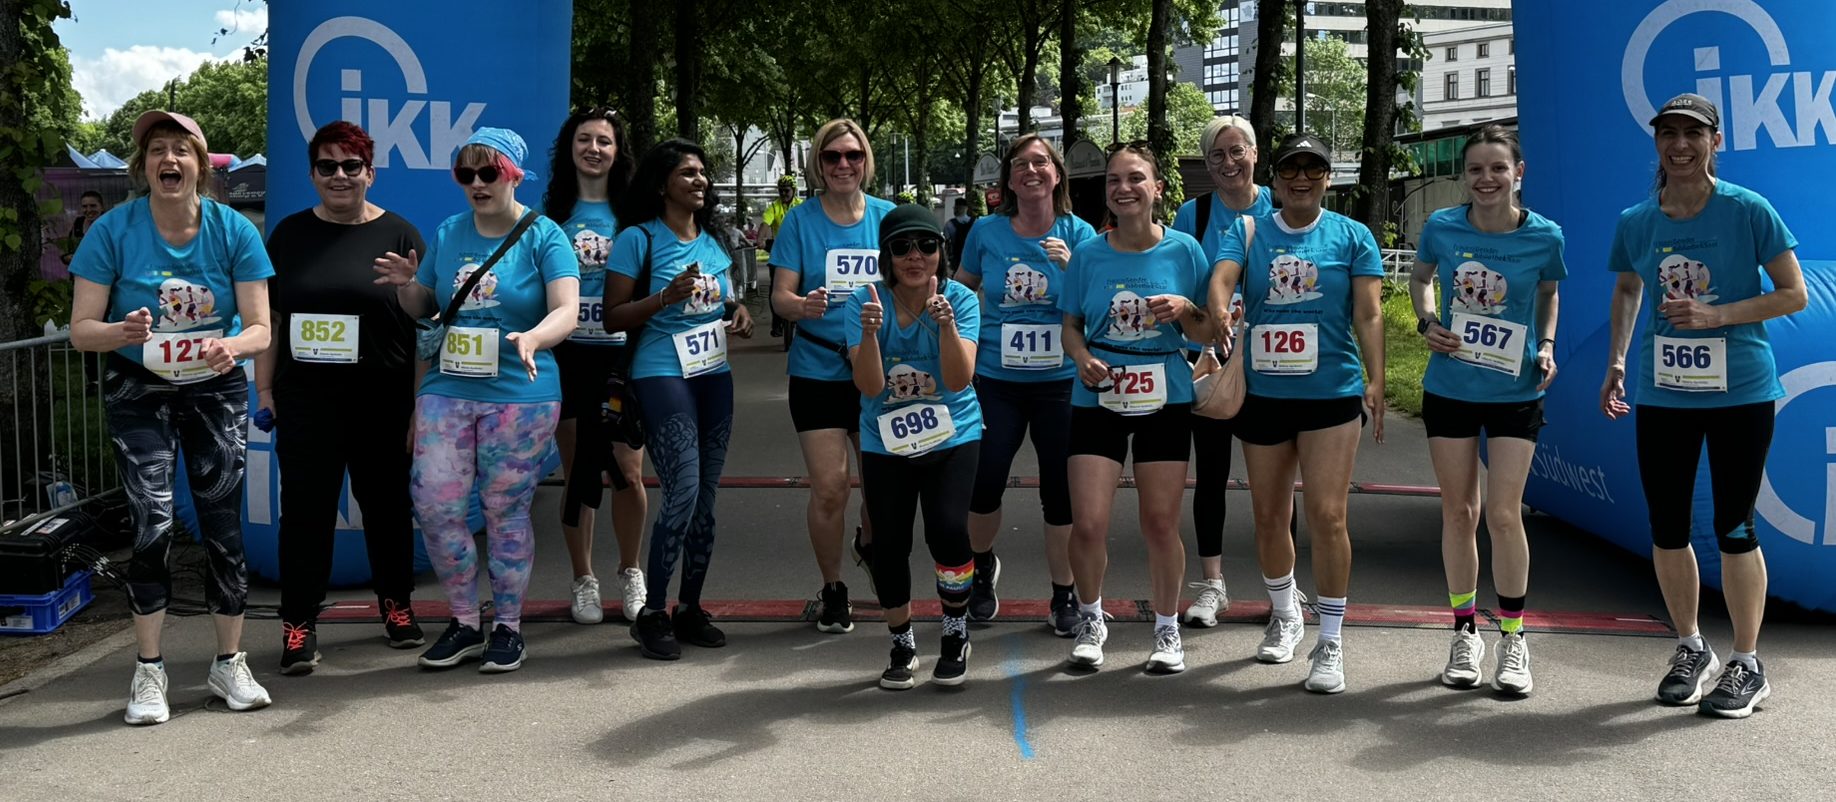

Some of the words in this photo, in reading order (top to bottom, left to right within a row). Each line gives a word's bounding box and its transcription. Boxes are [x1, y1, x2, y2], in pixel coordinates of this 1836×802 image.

[837, 255, 878, 275] 570
[578, 303, 603, 323] 56
[301, 320, 346, 342] 852
[685, 328, 719, 355] 571
[1010, 331, 1052, 352] 411
[1262, 330, 1305, 353] 126
[1463, 321, 1513, 350] 567
[159, 338, 208, 363] 127
[447, 333, 483, 355] 851
[1662, 344, 1712, 369] 566
[891, 407, 939, 440] 698
[1531, 443, 1615, 504] Südwest
